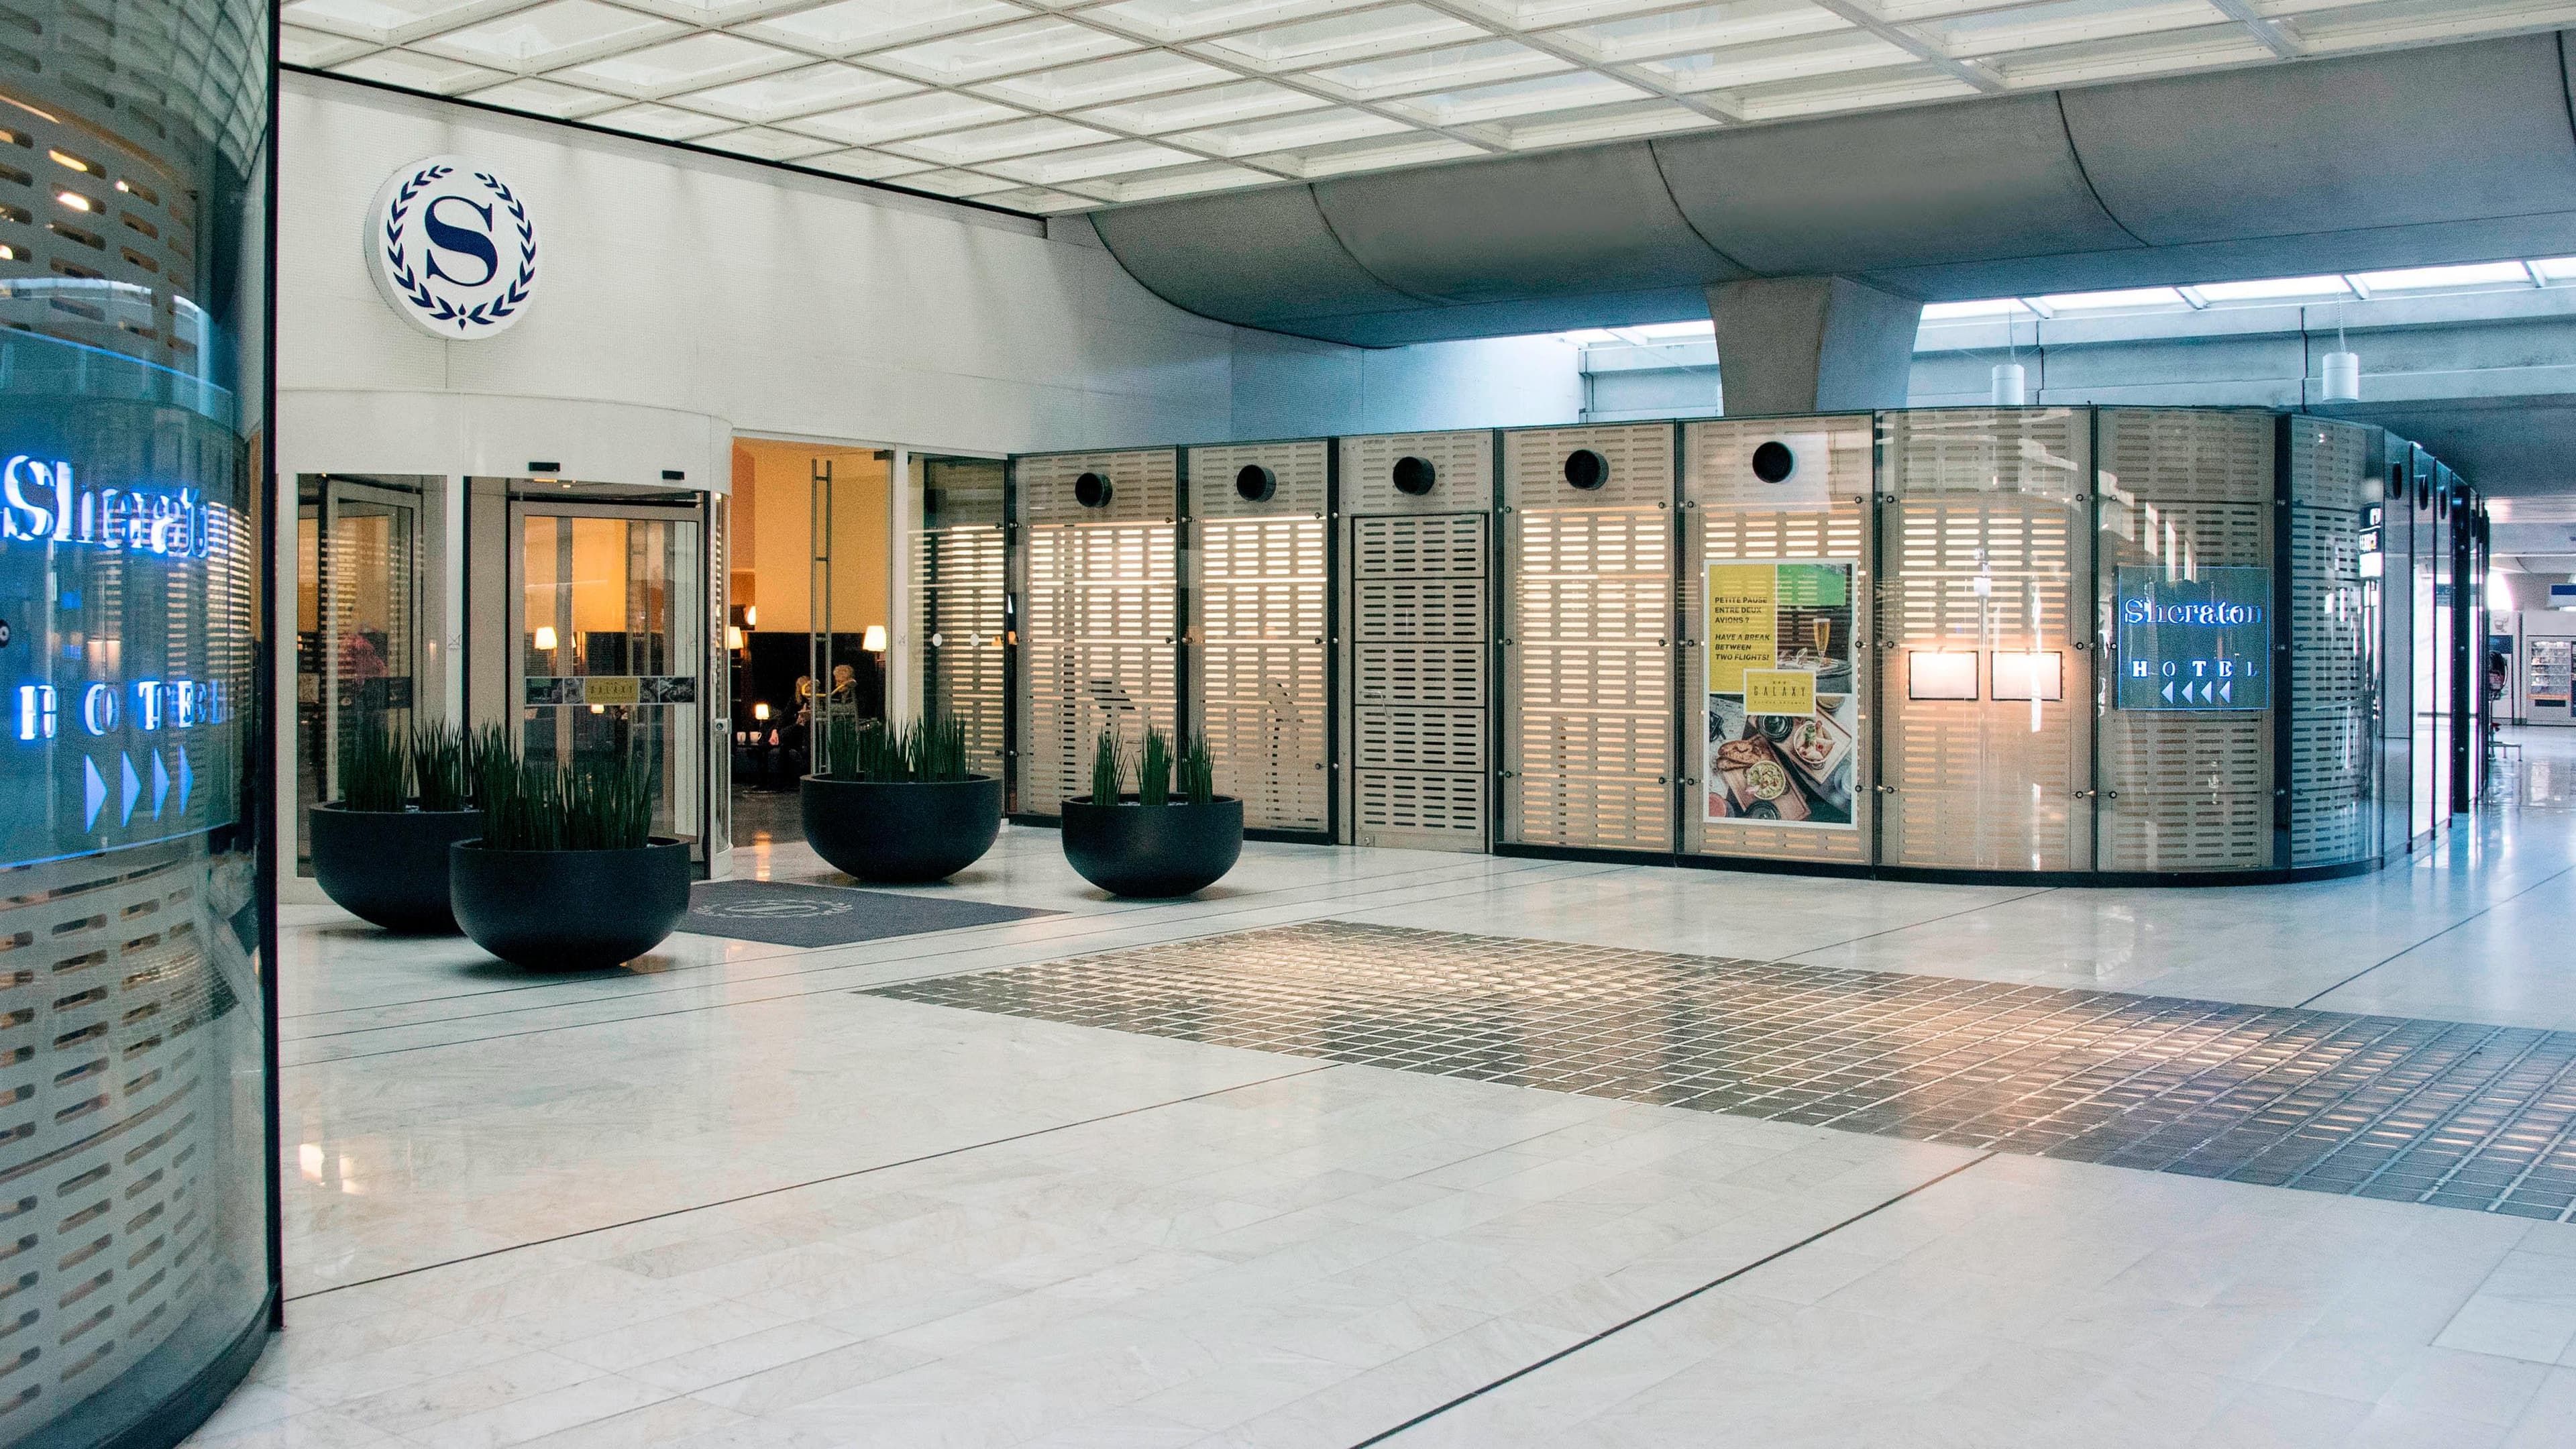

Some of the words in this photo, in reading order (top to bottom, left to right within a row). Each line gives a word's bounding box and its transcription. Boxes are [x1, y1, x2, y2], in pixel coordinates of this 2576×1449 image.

[425, 195, 499, 287] S
[2125, 598, 2262, 623] Sheraton
[2132, 660, 2258, 678] HOTEL
[1754, 686, 1805, 696] GALAXY
